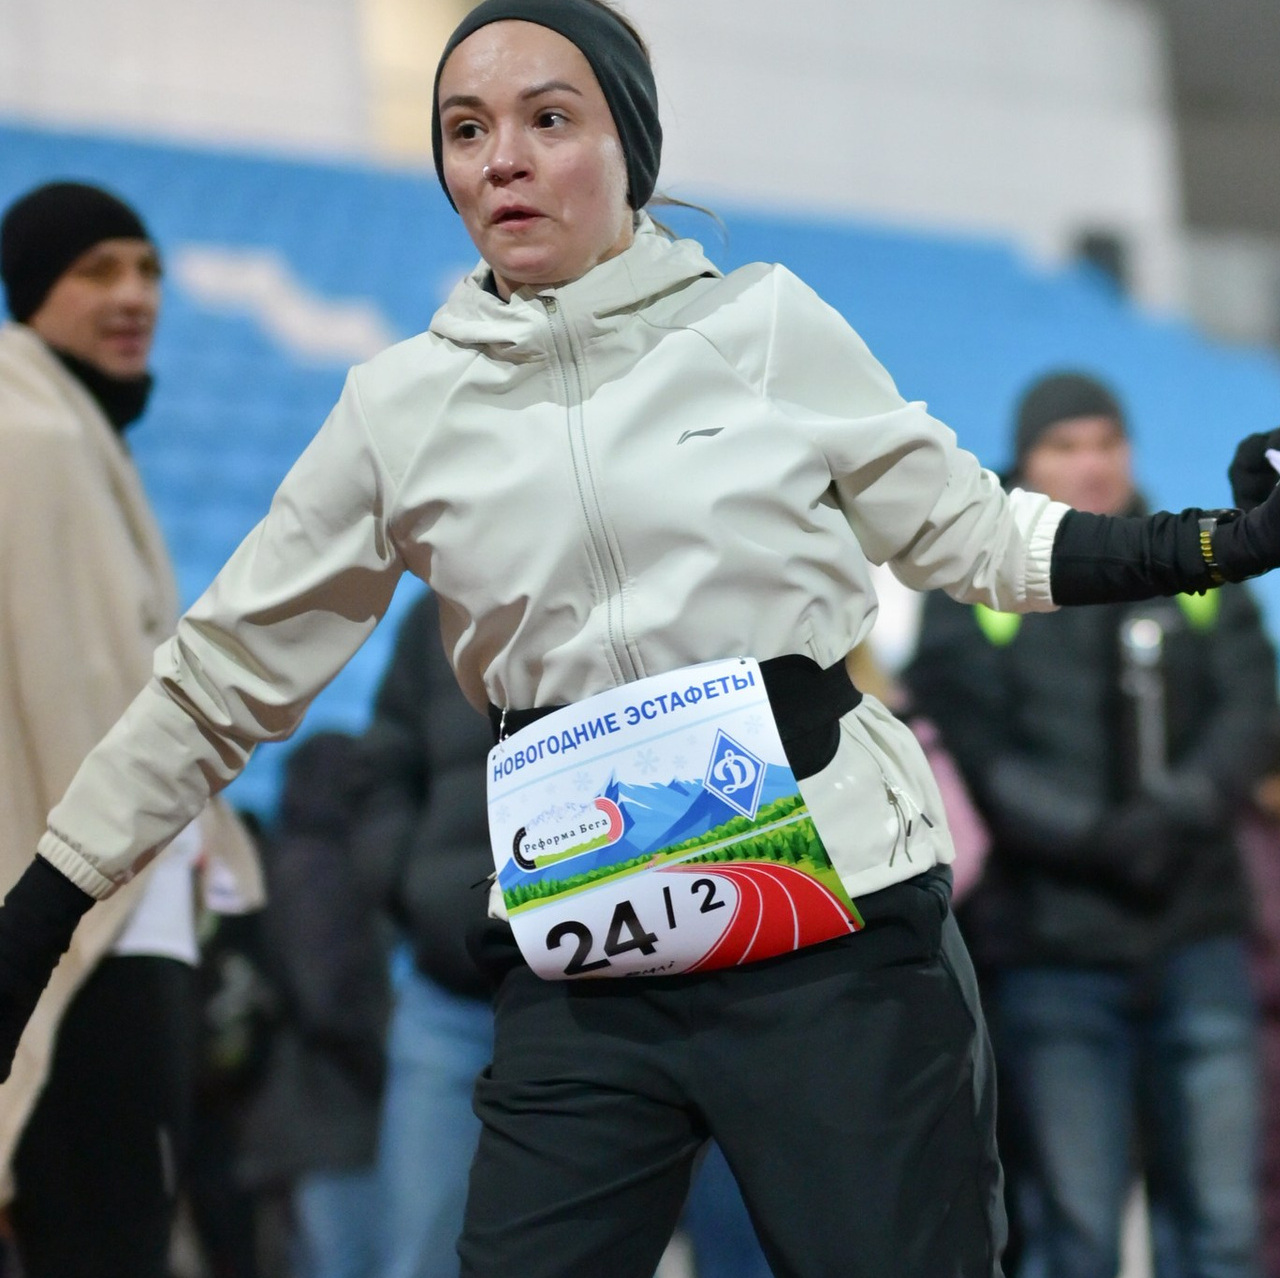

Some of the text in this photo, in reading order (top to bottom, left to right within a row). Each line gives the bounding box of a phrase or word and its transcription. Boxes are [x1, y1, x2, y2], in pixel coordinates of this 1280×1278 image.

[493, 671, 756, 782] НОВОГОДНИЕ ЭСТАФЕТЫ
[524, 818, 609, 853] Реформа Бега
